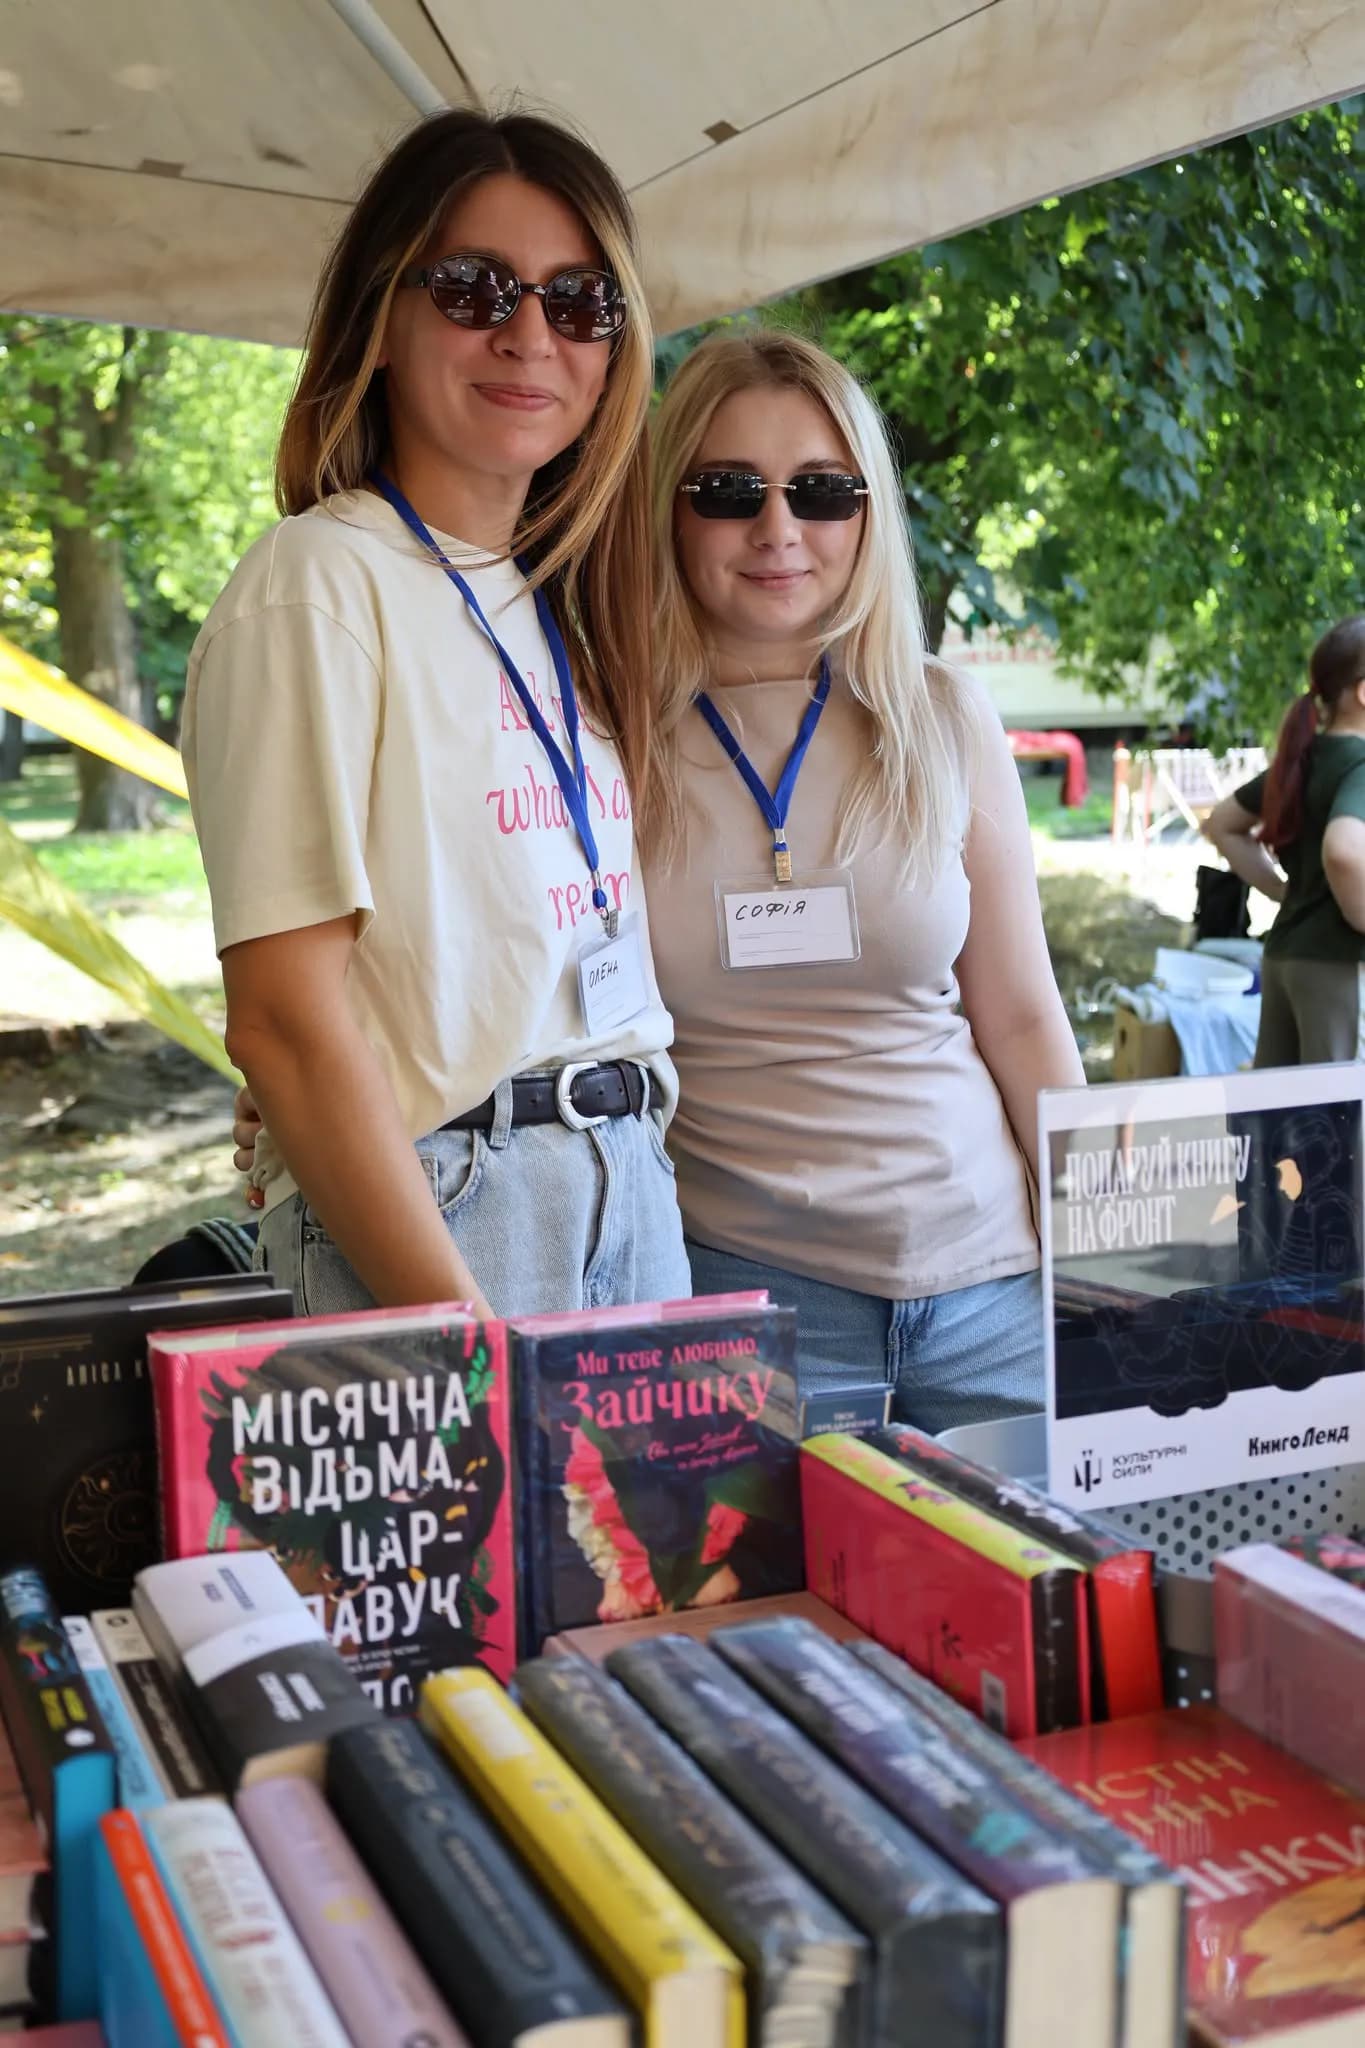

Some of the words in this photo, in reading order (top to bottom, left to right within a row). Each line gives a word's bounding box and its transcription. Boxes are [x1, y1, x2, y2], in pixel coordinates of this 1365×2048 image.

[499, 671, 555, 732] Ak
[486, 764, 571, 835] wha
[588, 959, 619, 989] ОЛЕНА
[1065, 1136, 1172, 1208] ПОДАРУЙ
[1175, 1135, 1252, 1190] КНИГУ
[1066, 1204, 1098, 1255] НА
[1098, 1195, 1177, 1250] ФРОНТ
[576, 1350, 609, 1377] Ми
[231, 1371, 472, 1455] МІСЯЧНА
[560, 1369, 775, 1433] Зайчику
[1112, 1444, 1187, 1467] КУЛЬТУРНІ
[1247, 1425, 1350, 1457] КнигоЛенд
[1112, 1463, 1152, 1480] СИЛИ
[1073, 1750, 1250, 1807] ІСТІН
[1178, 1823, 1365, 1908] ІНКИ
